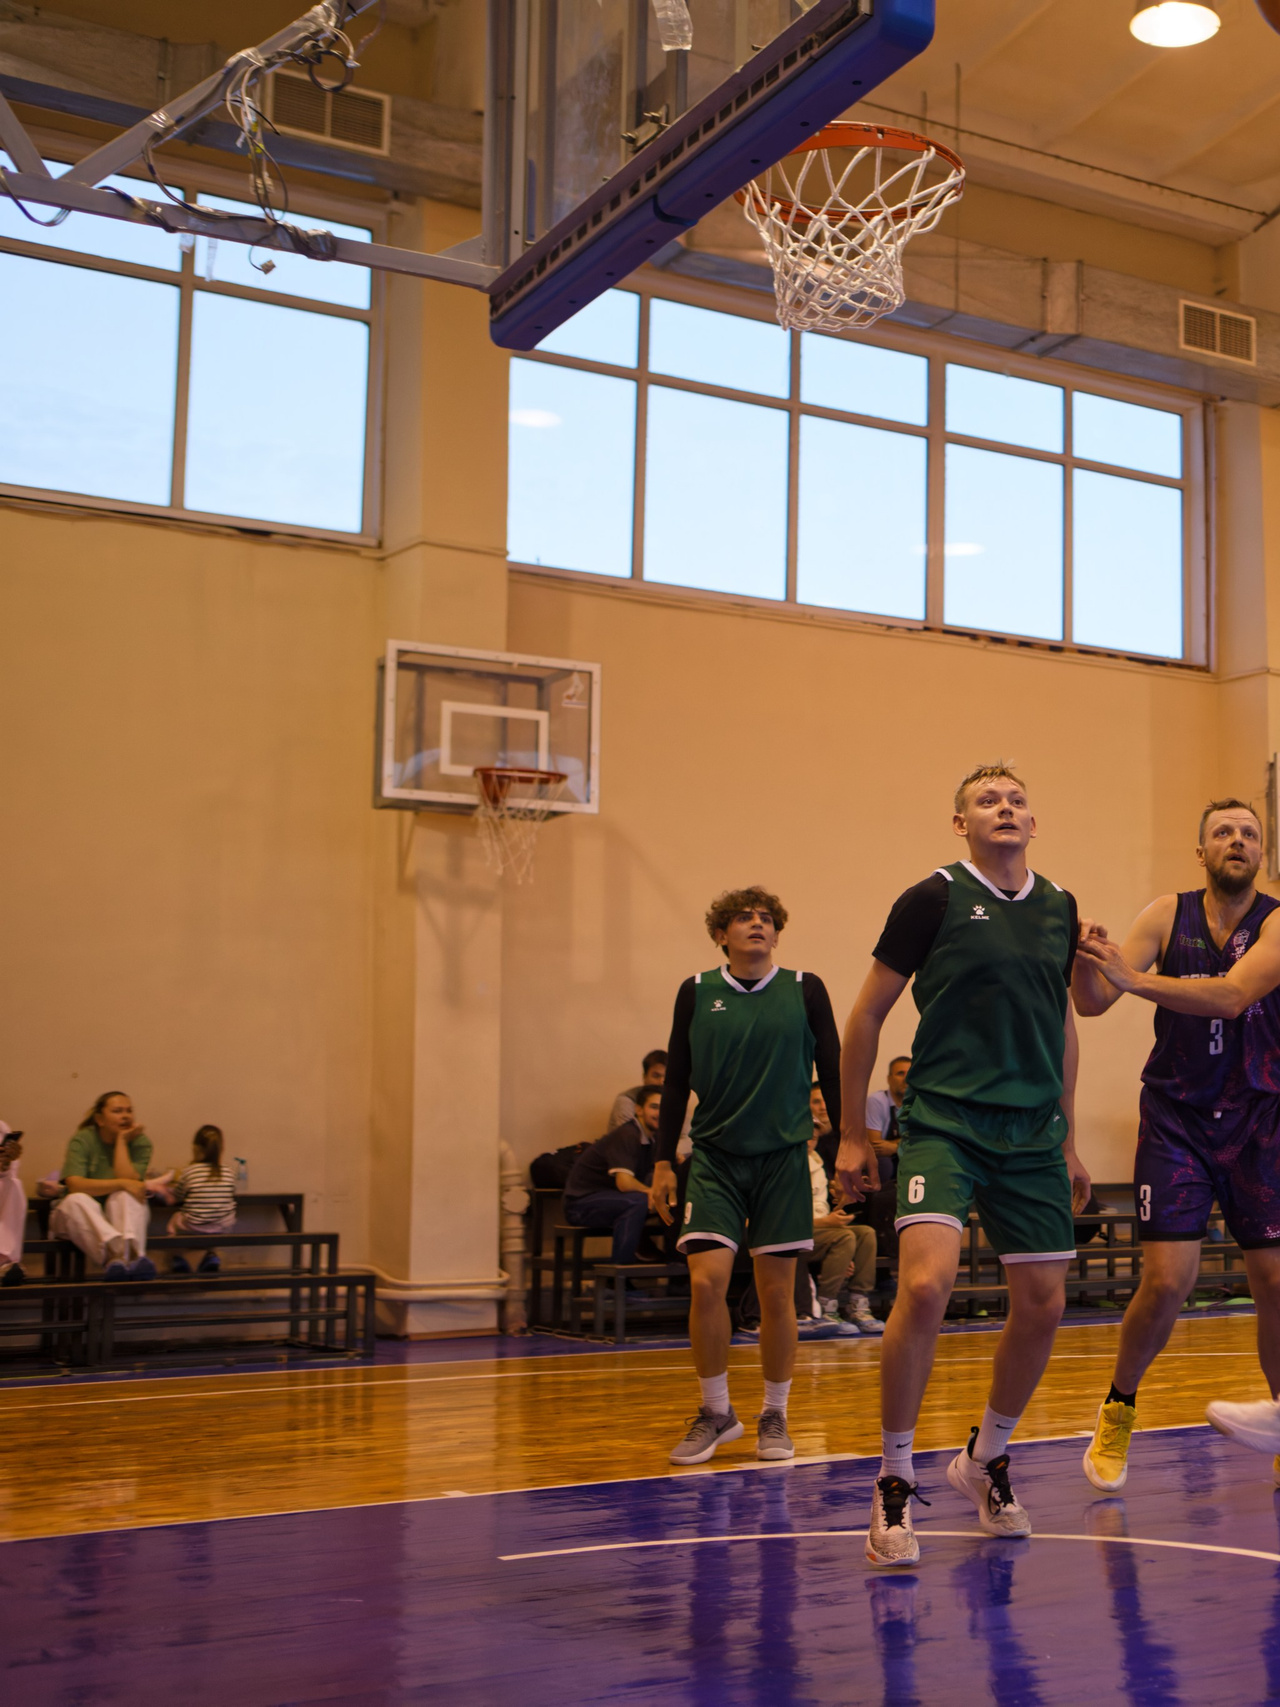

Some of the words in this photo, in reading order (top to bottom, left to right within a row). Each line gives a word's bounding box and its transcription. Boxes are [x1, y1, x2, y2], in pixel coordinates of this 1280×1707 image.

[1209, 1018, 1223, 1054] 3
[908, 1175, 925, 1203] 6
[1140, 1185, 1151, 1221] 3
